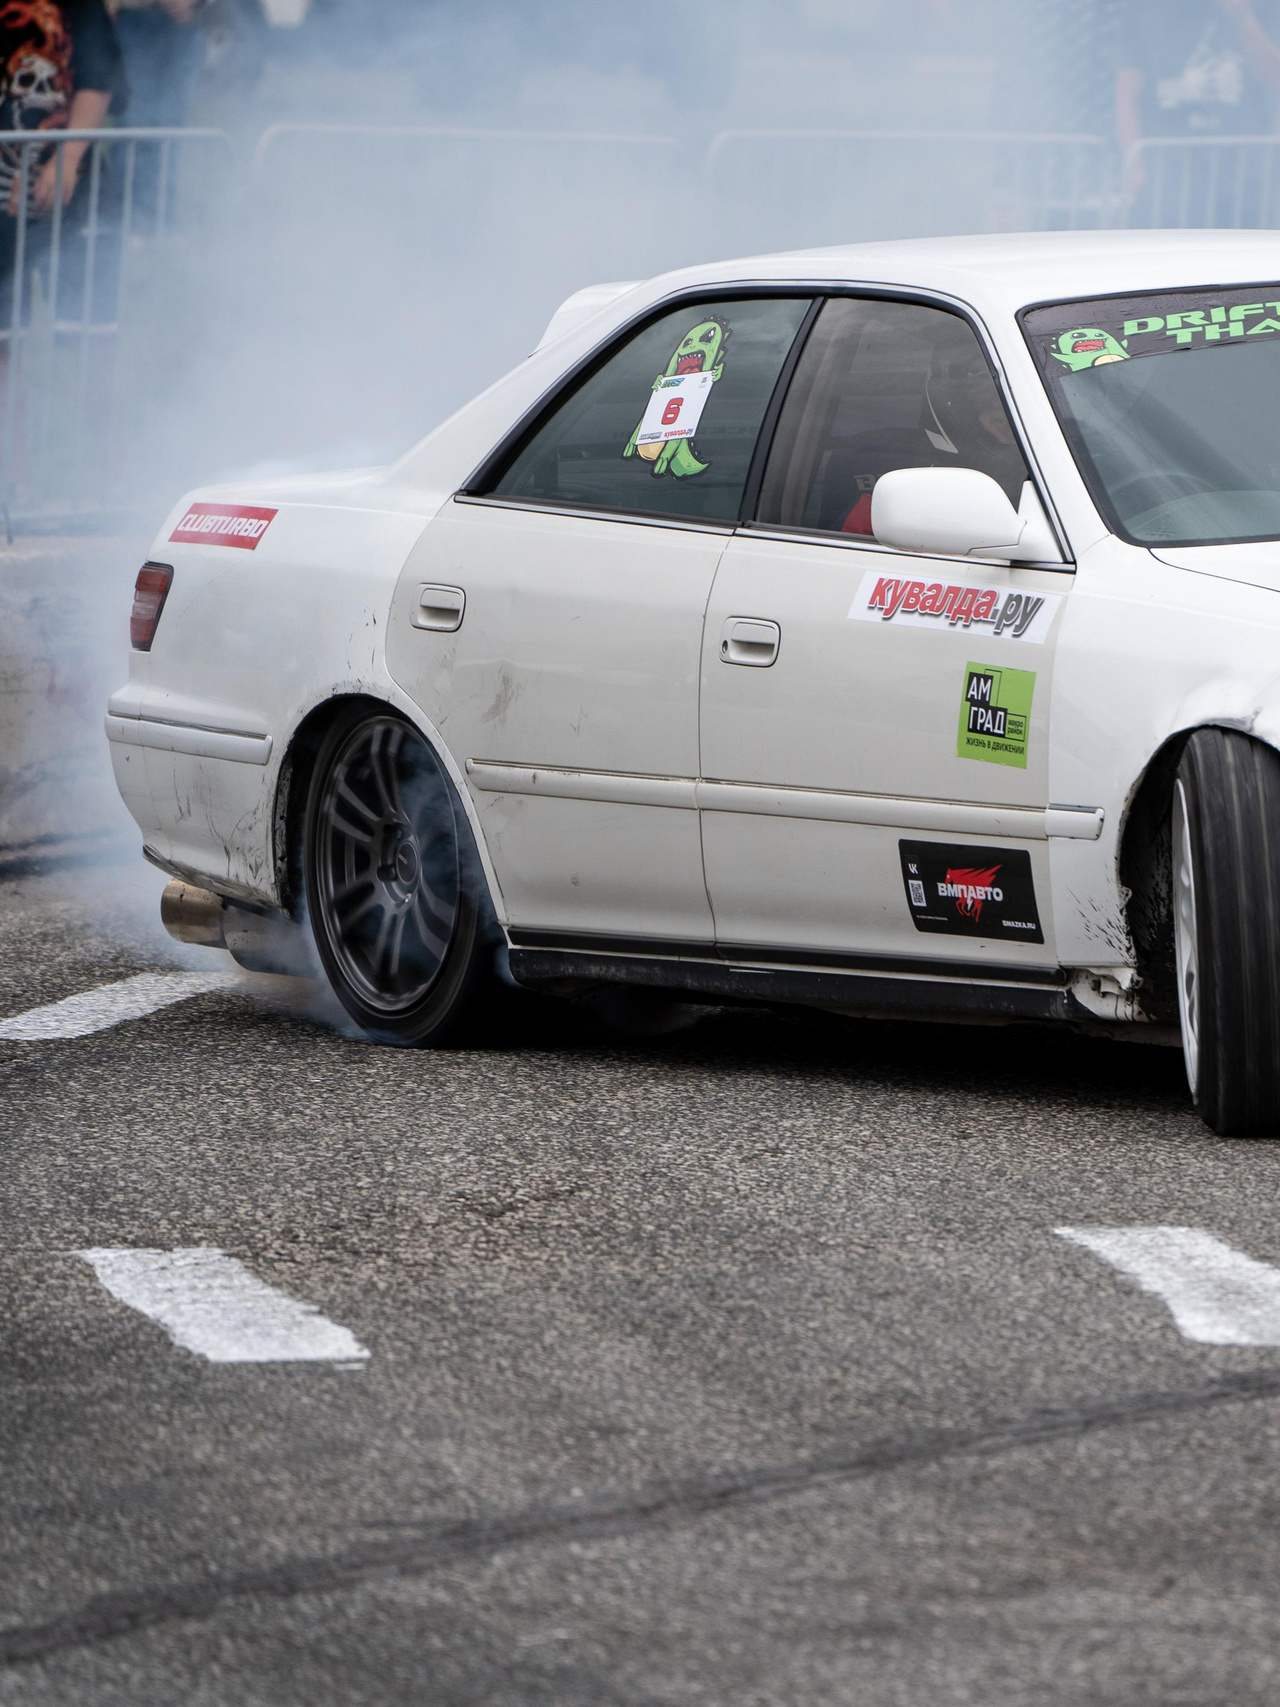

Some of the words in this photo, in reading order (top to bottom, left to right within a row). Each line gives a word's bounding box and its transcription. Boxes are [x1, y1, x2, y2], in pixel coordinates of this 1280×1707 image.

[661, 397, 684, 425] 6
[176, 513, 269, 539] CLUBTURBO
[967, 676, 992, 702] АМ
[969, 706, 1005, 734] ГРАД
[966, 737, 986, 748] ЖИЗНЬ
[991, 742, 1025, 755] ДВИЖЕНИИ
[937, 882, 1003, 902] ВМПАВТО
